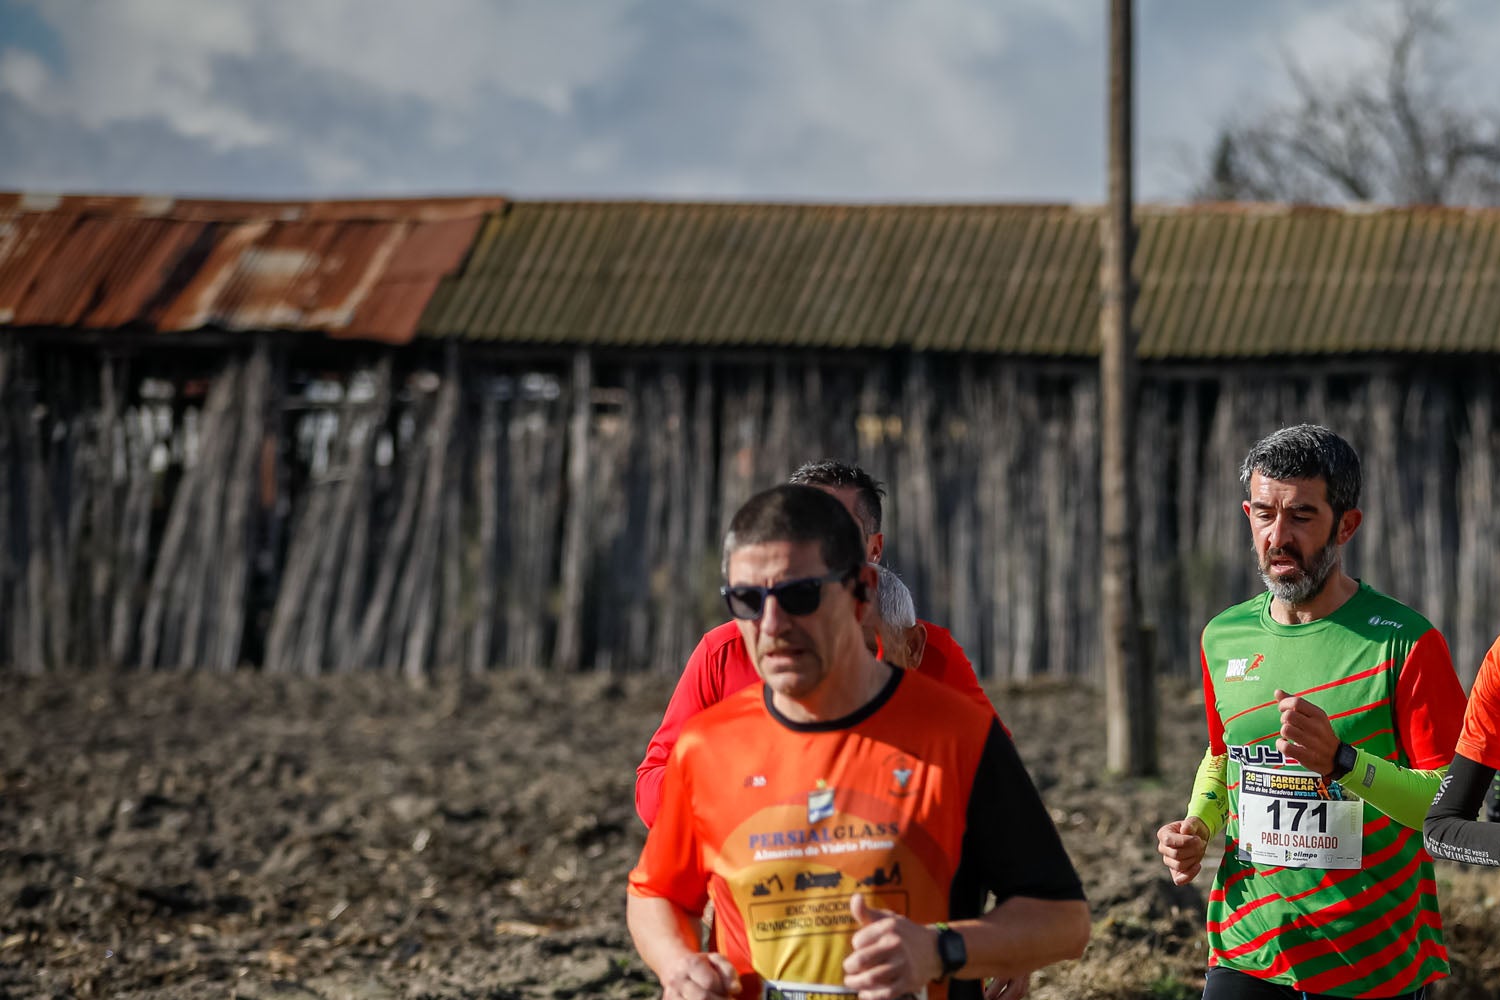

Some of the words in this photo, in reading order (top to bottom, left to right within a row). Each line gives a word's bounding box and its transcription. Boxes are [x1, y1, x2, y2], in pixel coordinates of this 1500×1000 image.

[1271, 774, 1315, 786] CARRERA
[1271, 782, 1315, 791] POPULAR
[1266, 799, 1328, 834] 171
[1261, 832, 1290, 848] PABLO
[1292, 835, 1338, 849] SALGADO
[1293, 851, 1318, 859] olimpo
